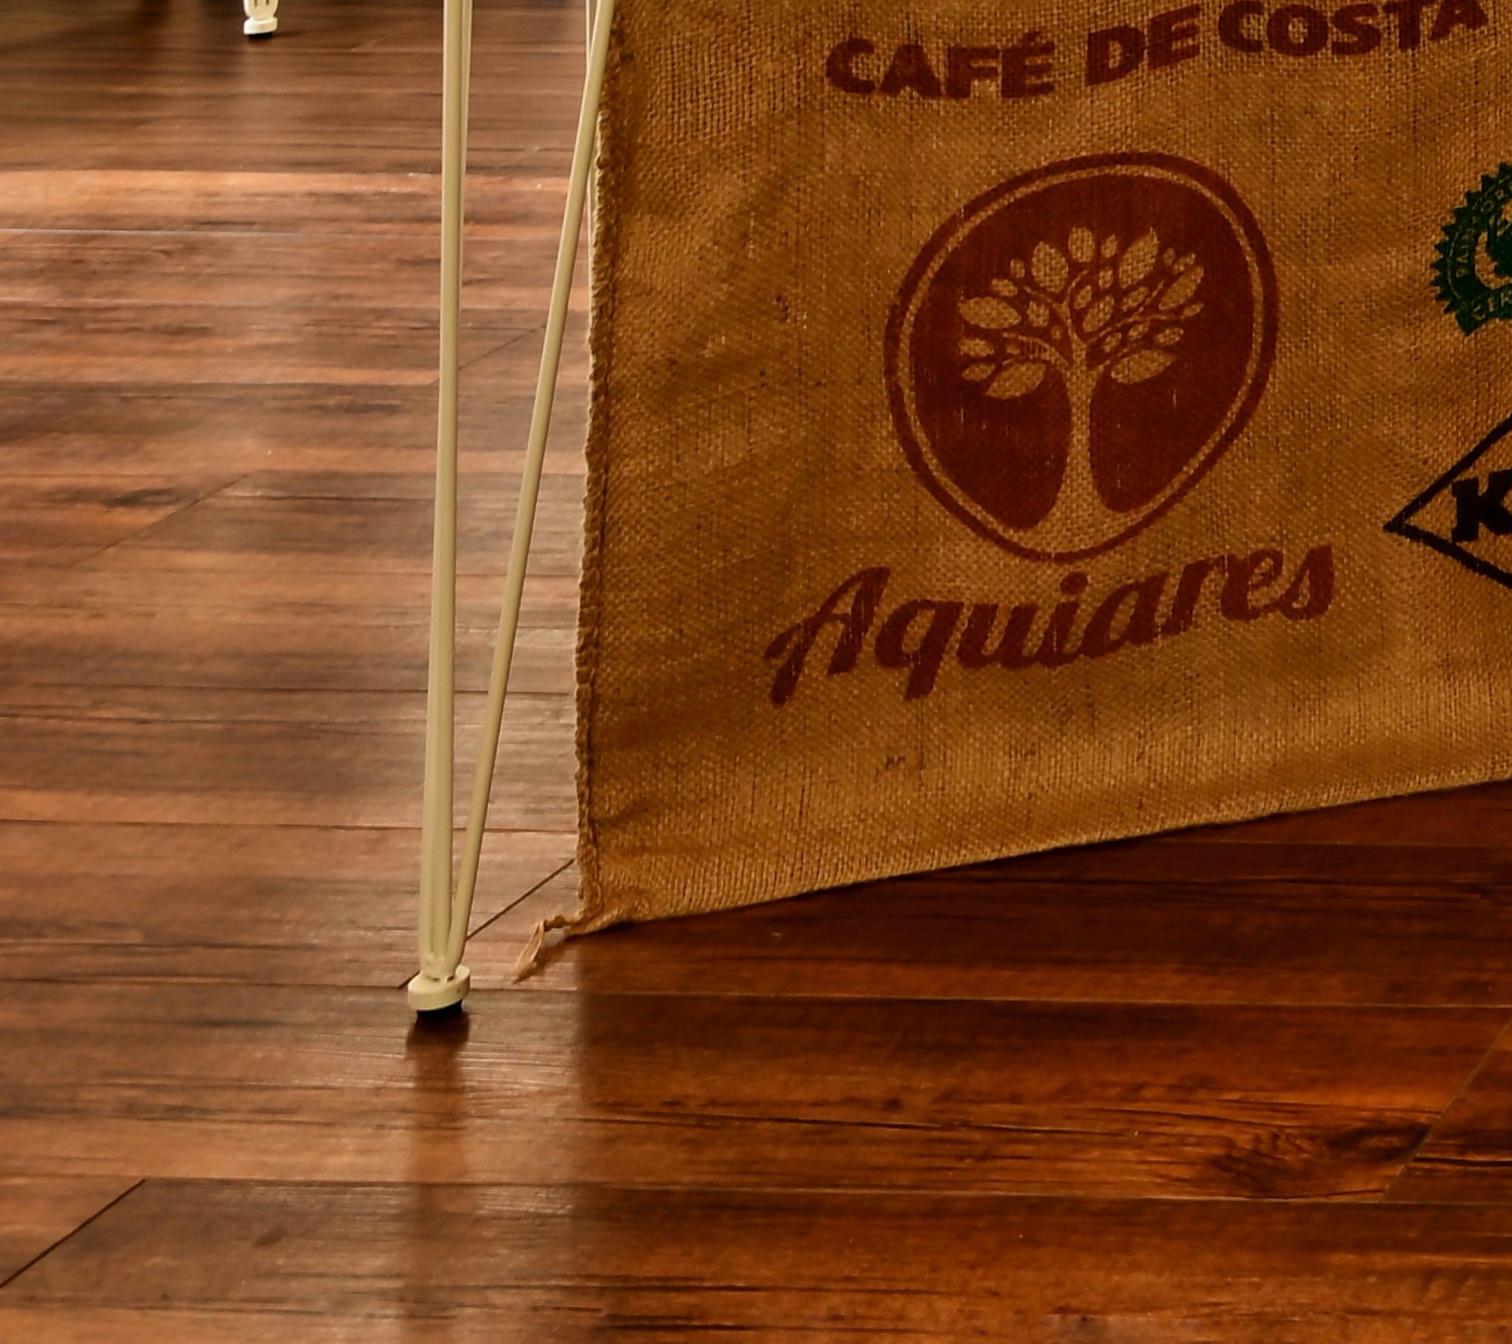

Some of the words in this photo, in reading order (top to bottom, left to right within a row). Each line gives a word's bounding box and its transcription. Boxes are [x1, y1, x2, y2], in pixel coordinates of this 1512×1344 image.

[823, 29, 1056, 99] CAFÉ
[1085, 4, 1201, 86] DE
[764, 544, 1336, 707] Aquiares
